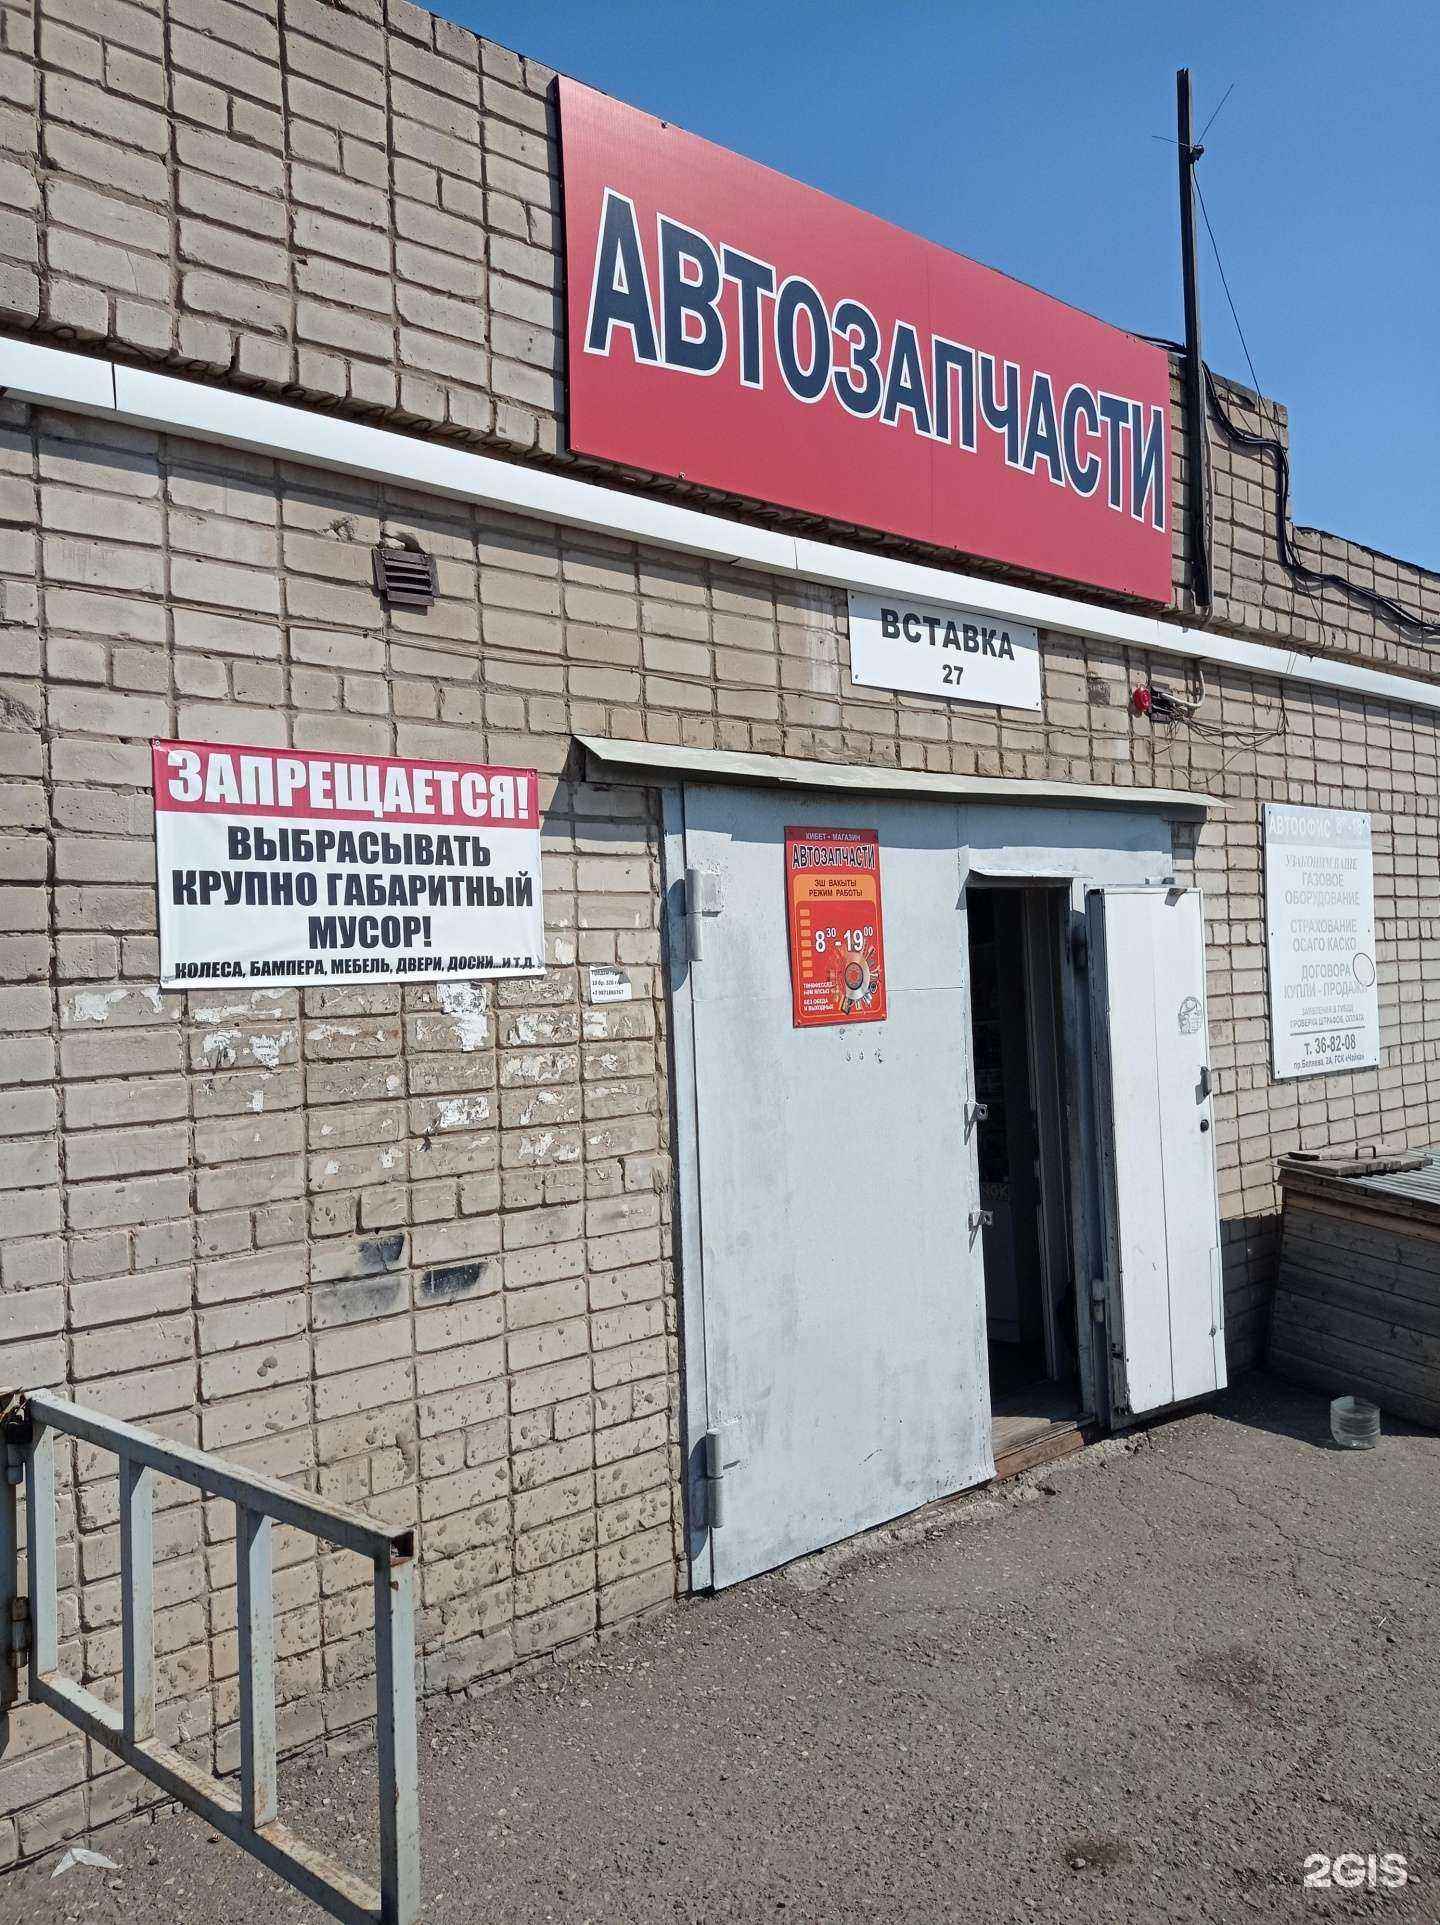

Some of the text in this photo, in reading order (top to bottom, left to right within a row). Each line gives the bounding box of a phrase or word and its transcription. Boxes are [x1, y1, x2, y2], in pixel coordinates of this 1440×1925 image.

[583, 186, 1166, 532] АВТОЗАПЧАСТИ
[881, 608, 1014, 660] ВСТАВКА
[942, 664, 963, 685] 27
[168, 750, 529, 819] ЗАПРЕЩАЕТСЯ!
[227, 826, 491, 867] ВЫБРАСЫВАТЬ
[832, 833, 861, 841] МАГАЗИН
[792, 844, 876, 870] АВТОЗАПЧАСТИ
[172, 870, 532, 907] КРУПНО ГАБАРИТНЫЙ
[1302, 872, 1344, 887] ГАЗОВОЕ
[1285, 890, 1360, 907] ОБОРУДОВАНИЕ
[308, 916, 432, 950] МУСОР!
[1290, 920, 1357, 933] СТРАХОВАНИЕ
[1293, 937, 1356, 952] ОСАГО КАСКО
[175, 961, 246, 979] КОЛЕСА,
[250, 960, 328, 976] БАМПЕРА,
[331, 958, 393, 974] МЕБЕЛЬ,
[396, 956, 444, 974] ДВЕРИ,
[1302, 963, 1351, 982] ДОГОВОРА
[1284, 984, 1316, 998] КУПЛИ
[1315, 1034, 1356, 1054] 36-82-08
